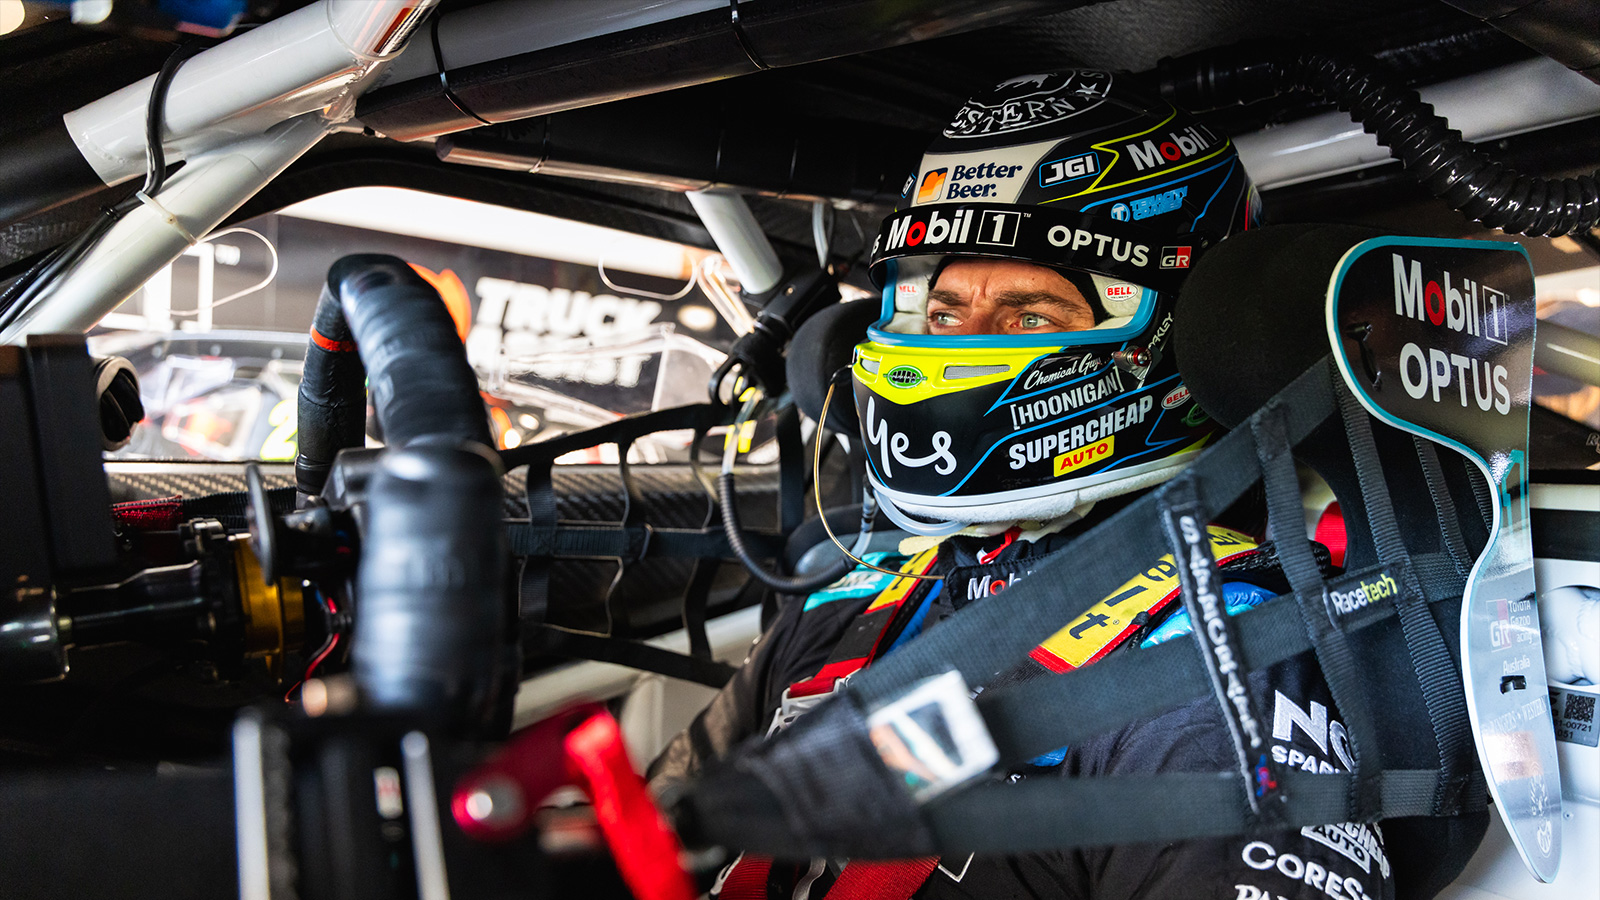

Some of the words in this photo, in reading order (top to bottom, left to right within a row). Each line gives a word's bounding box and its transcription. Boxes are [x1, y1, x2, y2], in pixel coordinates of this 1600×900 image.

[1125, 126, 1210, 171] Mobil
[951, 162, 1023, 181] Better
[1045, 154, 1095, 184] JGI
[946, 182, 997, 200] Beer.
[885, 209, 974, 252] Mobil
[992, 214, 1006, 242] 1
[1047, 225, 1150, 267] OPTUS
[1161, 255, 1190, 267] GR
[1107, 286, 1132, 296] BELL
[1392, 253, 1480, 337] Mobil
[1489, 295, 1500, 338] 1
[475, 276, 662, 338] TRUCK
[1023, 363, 1077, 391] Chemical
[1400, 342, 1511, 416] OPTUS
[1009, 395, 1153, 470] SUPERCHEAP
[1060, 442, 1108, 470] AUTO
[1330, 574, 1397, 616] Racetech
[1508, 600, 1531, 612] TOYOTA
[1503, 654, 1531, 674] Australia
[1555, 719, 1592, 732] 1-00721
[1313, 826, 1365, 861] AUTO
